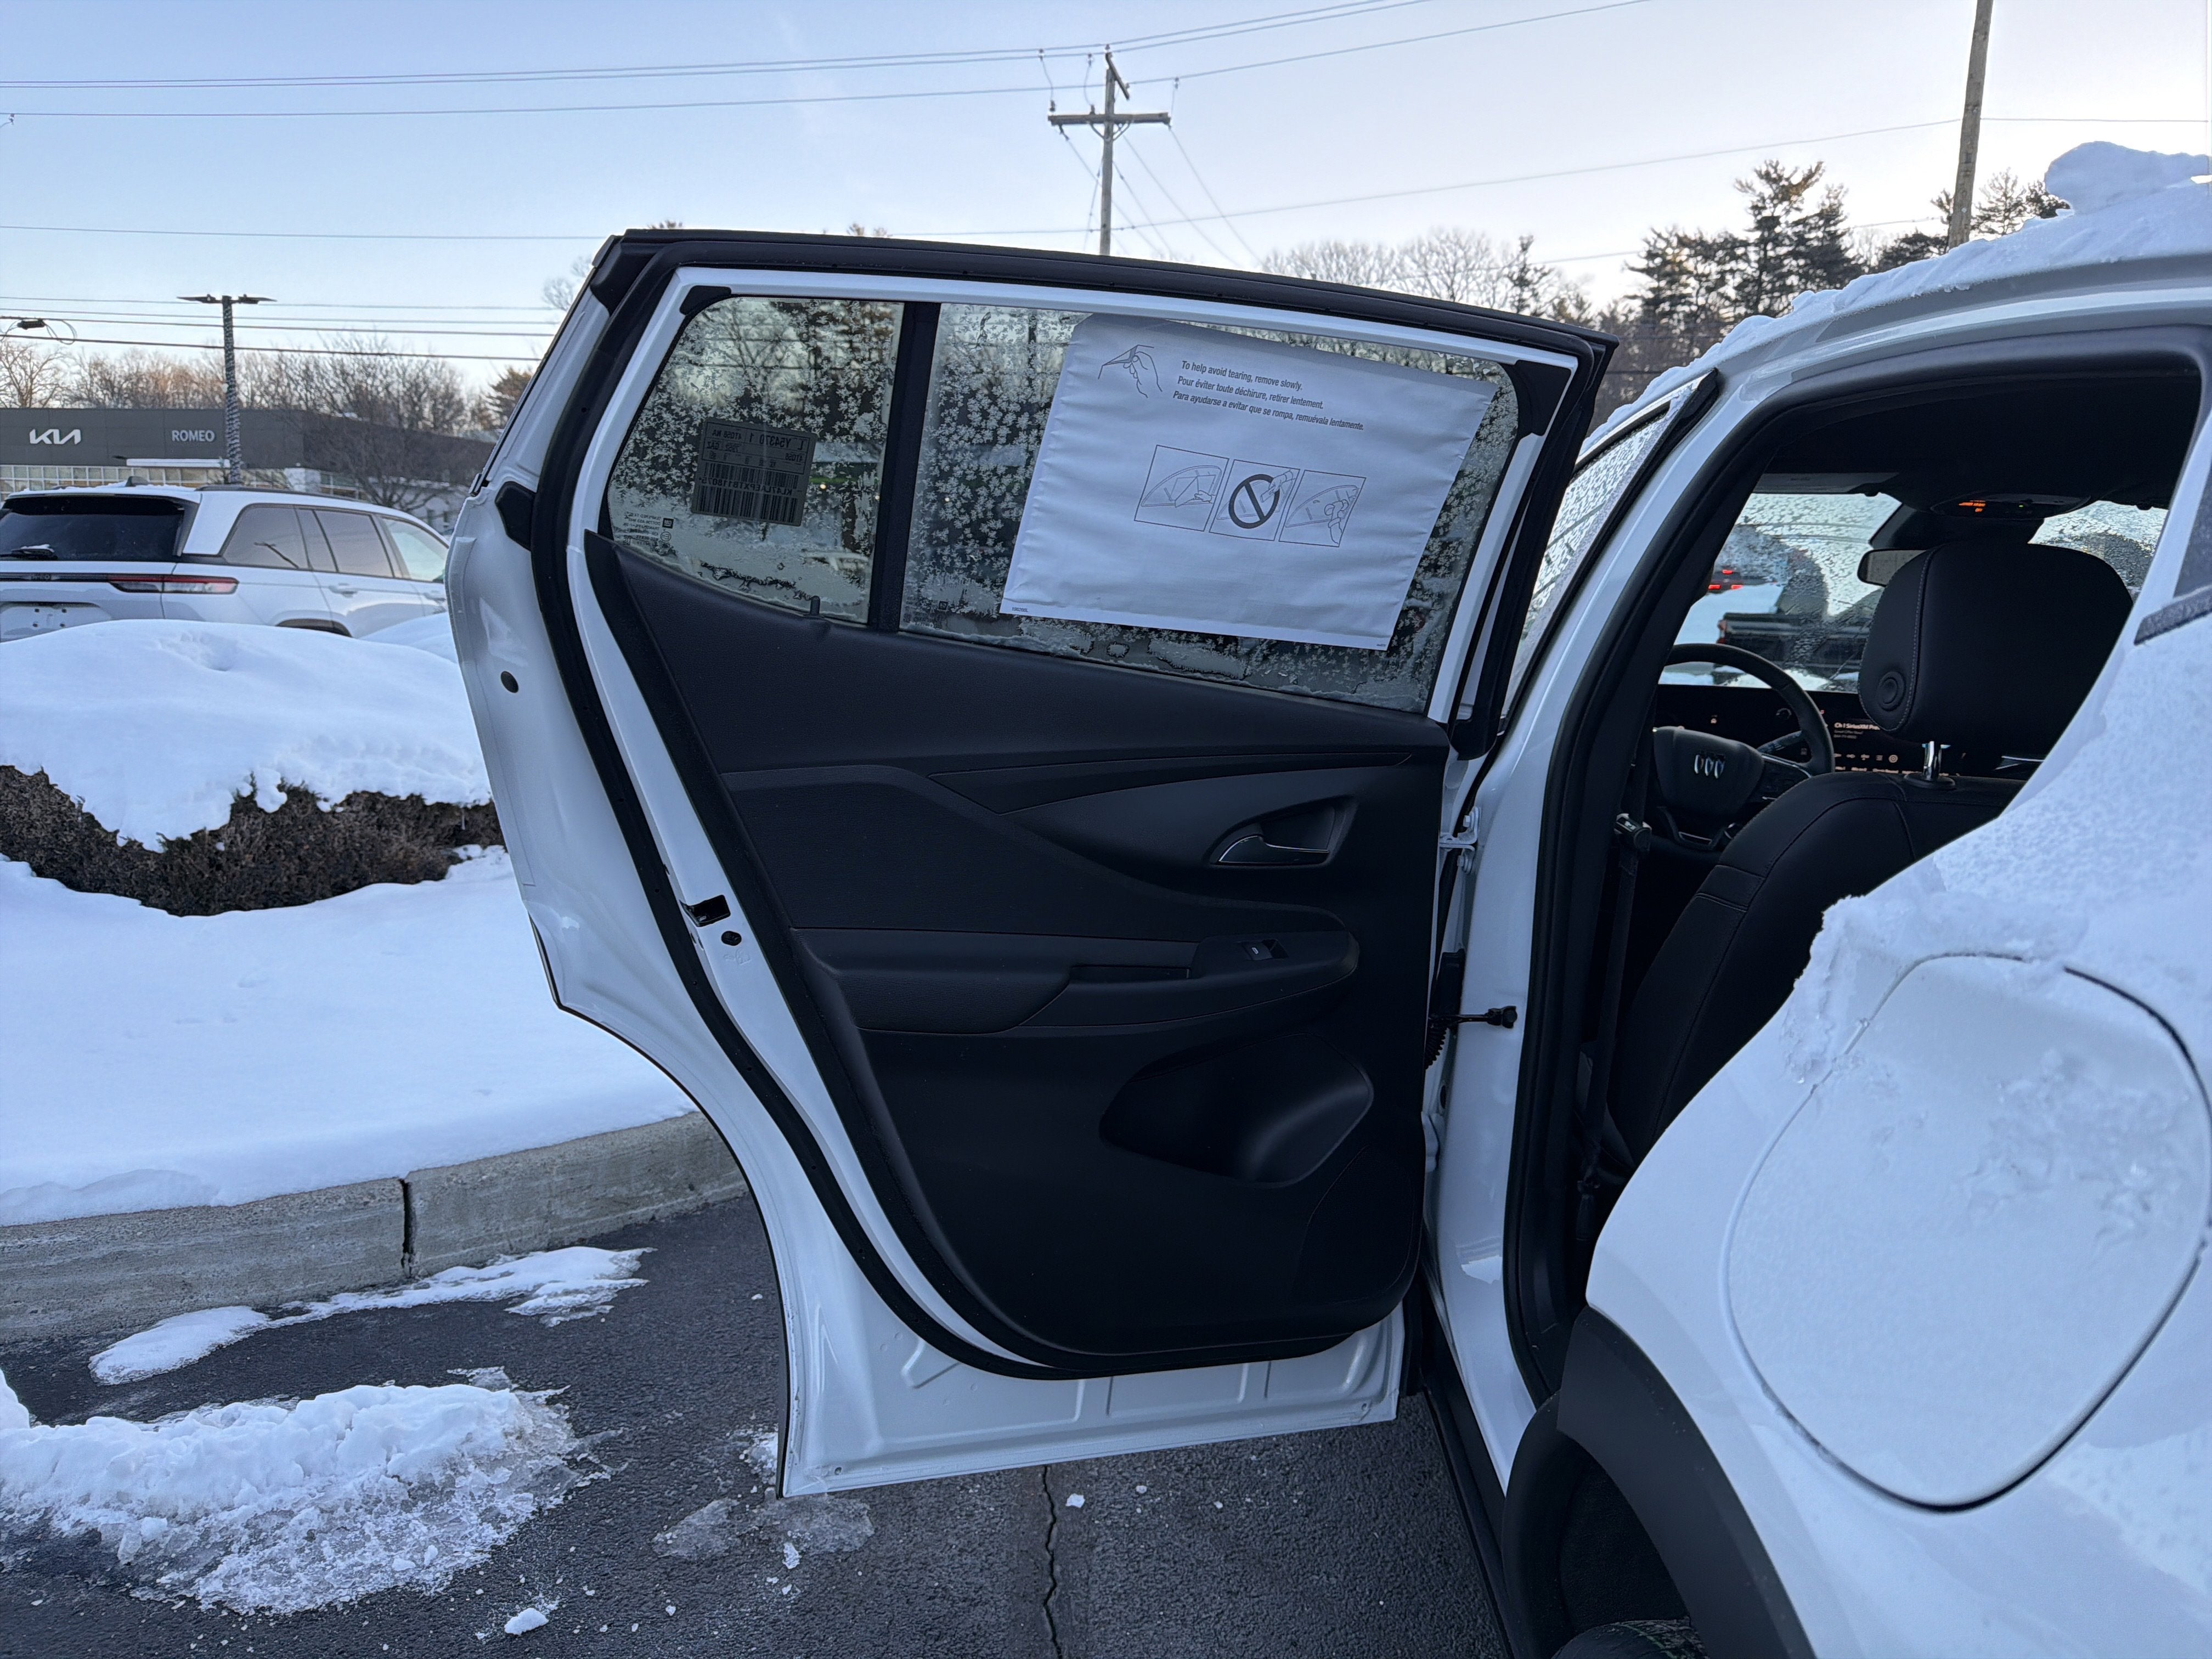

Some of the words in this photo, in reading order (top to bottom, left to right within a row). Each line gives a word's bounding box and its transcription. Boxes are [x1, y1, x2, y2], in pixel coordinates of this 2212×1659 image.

[1182, 360, 1190, 369] To
[1191, 362, 1206, 374] help
[1207, 367, 1227, 376] avoid
[1228, 369, 1252, 383] tearing,
[1255, 376, 1279, 386] remove
[1280, 380, 1302, 391] slowly.
[1177, 376, 1194, 386] Pour
[1195, 379, 1215, 390] éviter
[1216, 383, 1233, 393] toute
[1235, 387, 1267, 401] déchirure,
[1269, 393, 1290, 403] retirer
[1290, 396, 1323, 409] lentement.
[1173, 390, 1189, 400] Para
[1190, 395, 1221, 406] ayudarse
[1228, 401, 1248, 411] evitar
[1249, 405, 1262, 414] que
[1272, 410, 1294, 421] rompa,
[1295, 414, 1329, 425] remuévala
[1329, 417, 1364, 431] lentamente.
[30, 429, 81, 444] KIA
[172, 430, 215, 442] ROMEO
